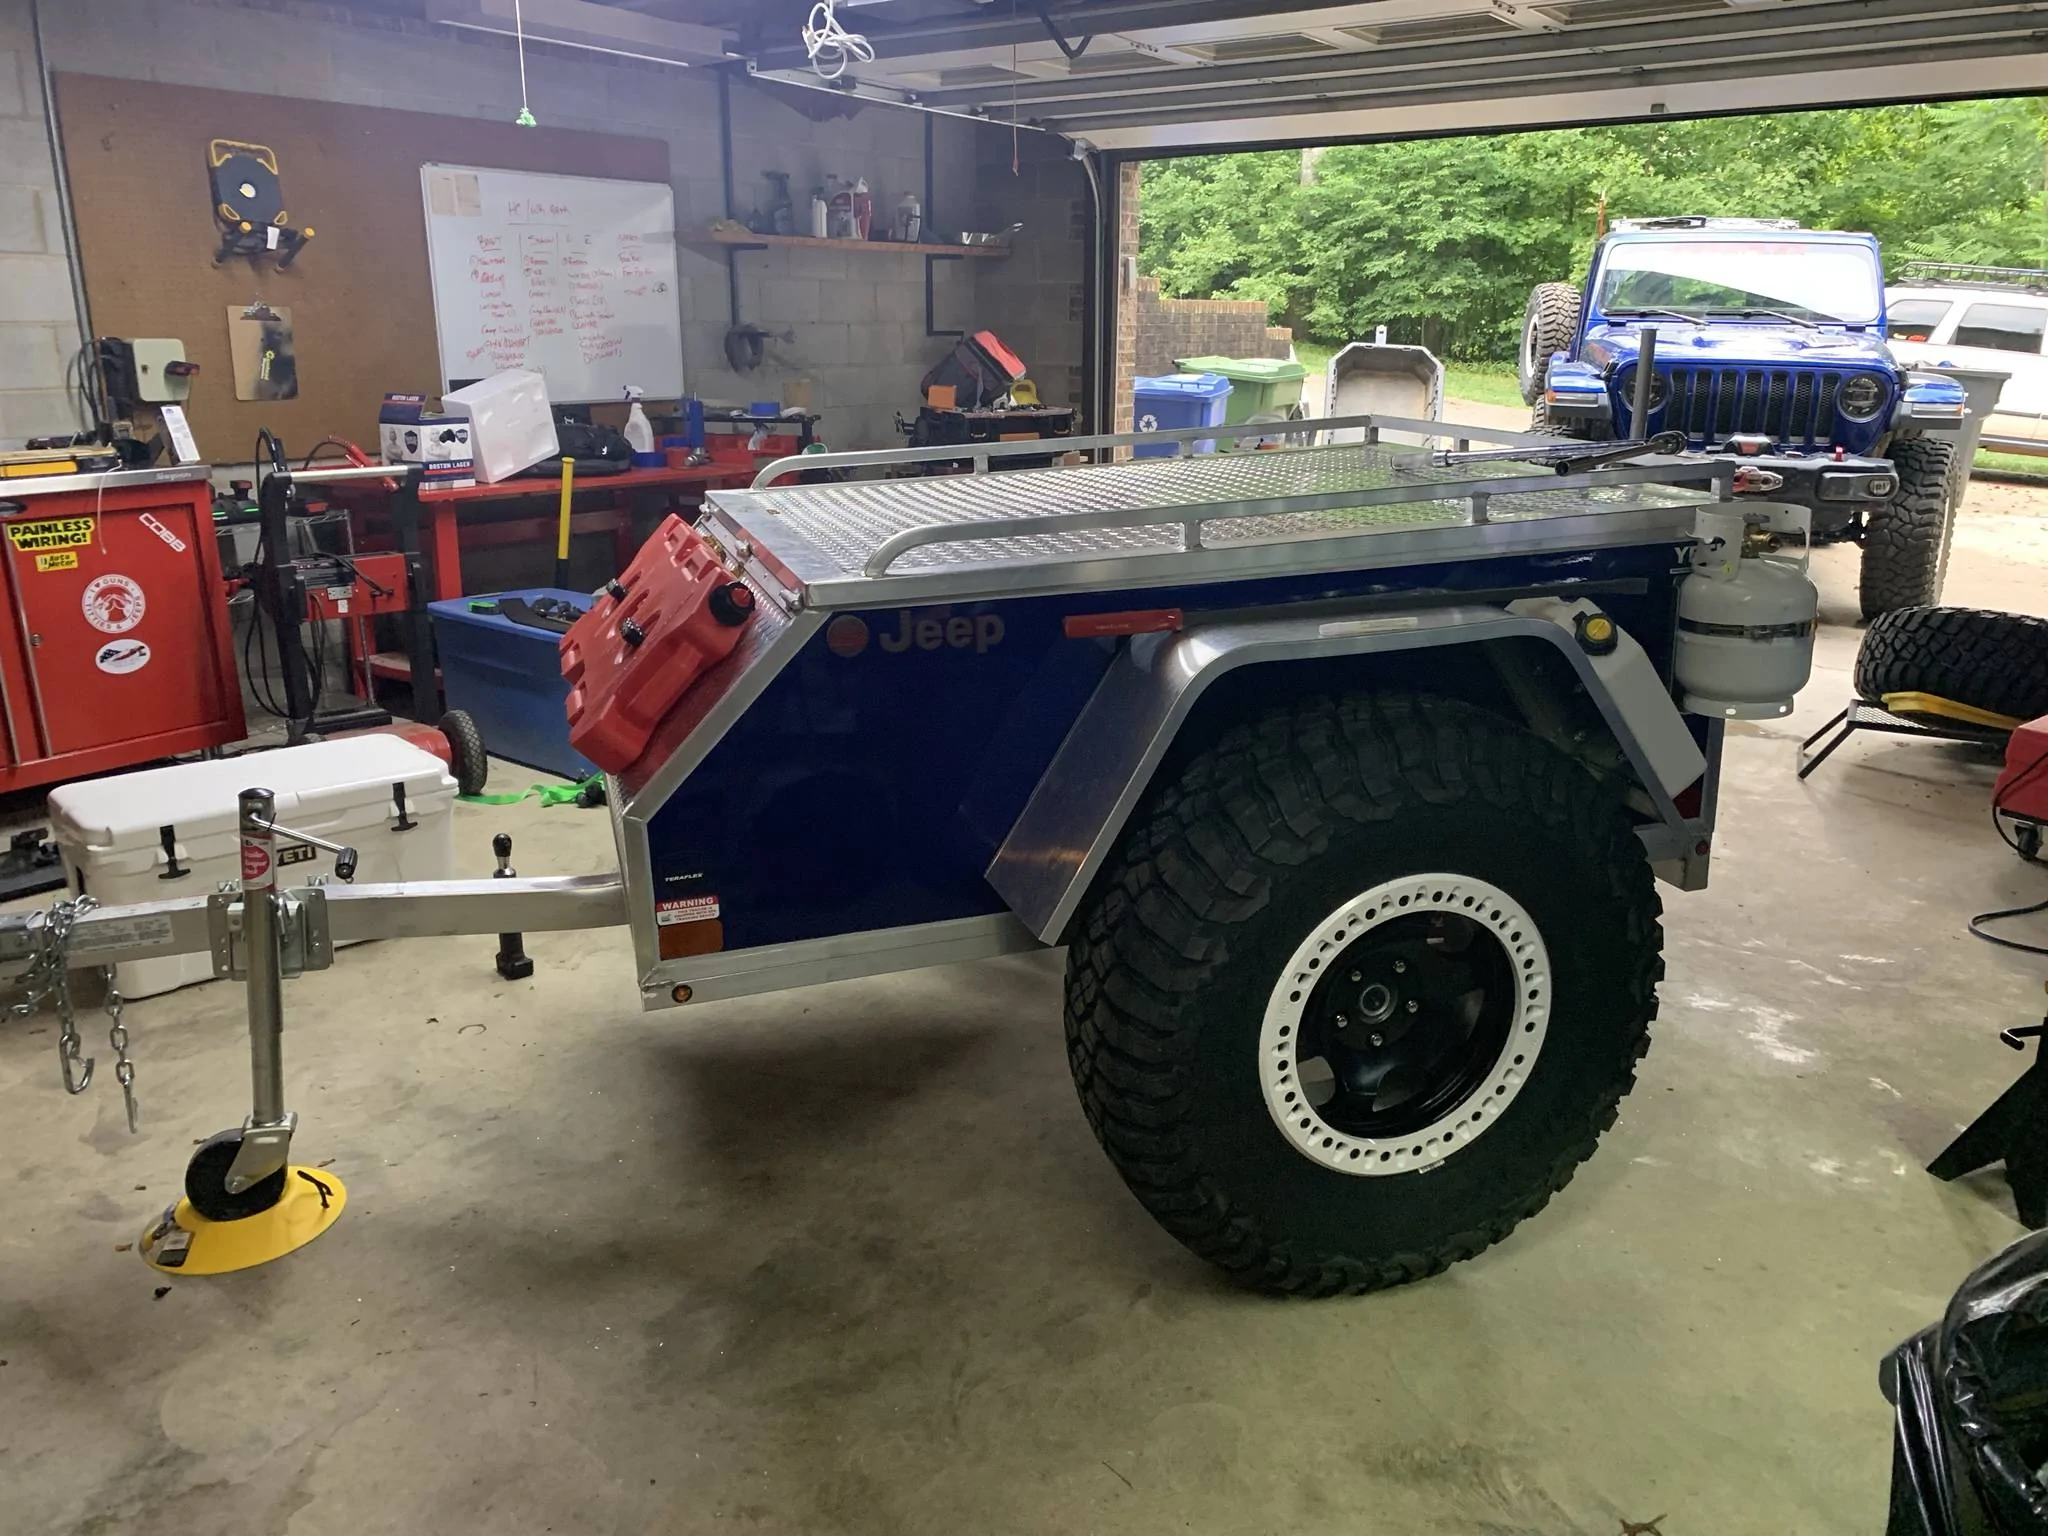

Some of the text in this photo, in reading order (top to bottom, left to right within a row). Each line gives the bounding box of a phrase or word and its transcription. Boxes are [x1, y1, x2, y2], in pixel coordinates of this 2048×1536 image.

[428, 462, 451, 470] BOSTON
[10, 520, 92, 537] PAINLESS
[139, 513, 186, 552] COBB
[17, 533, 87, 549] WIRING!
[879, 610, 1005, 654] Jeep
[665, 873, 703, 882] TERAFLEX
[662, 897, 714, 910] WARNING
